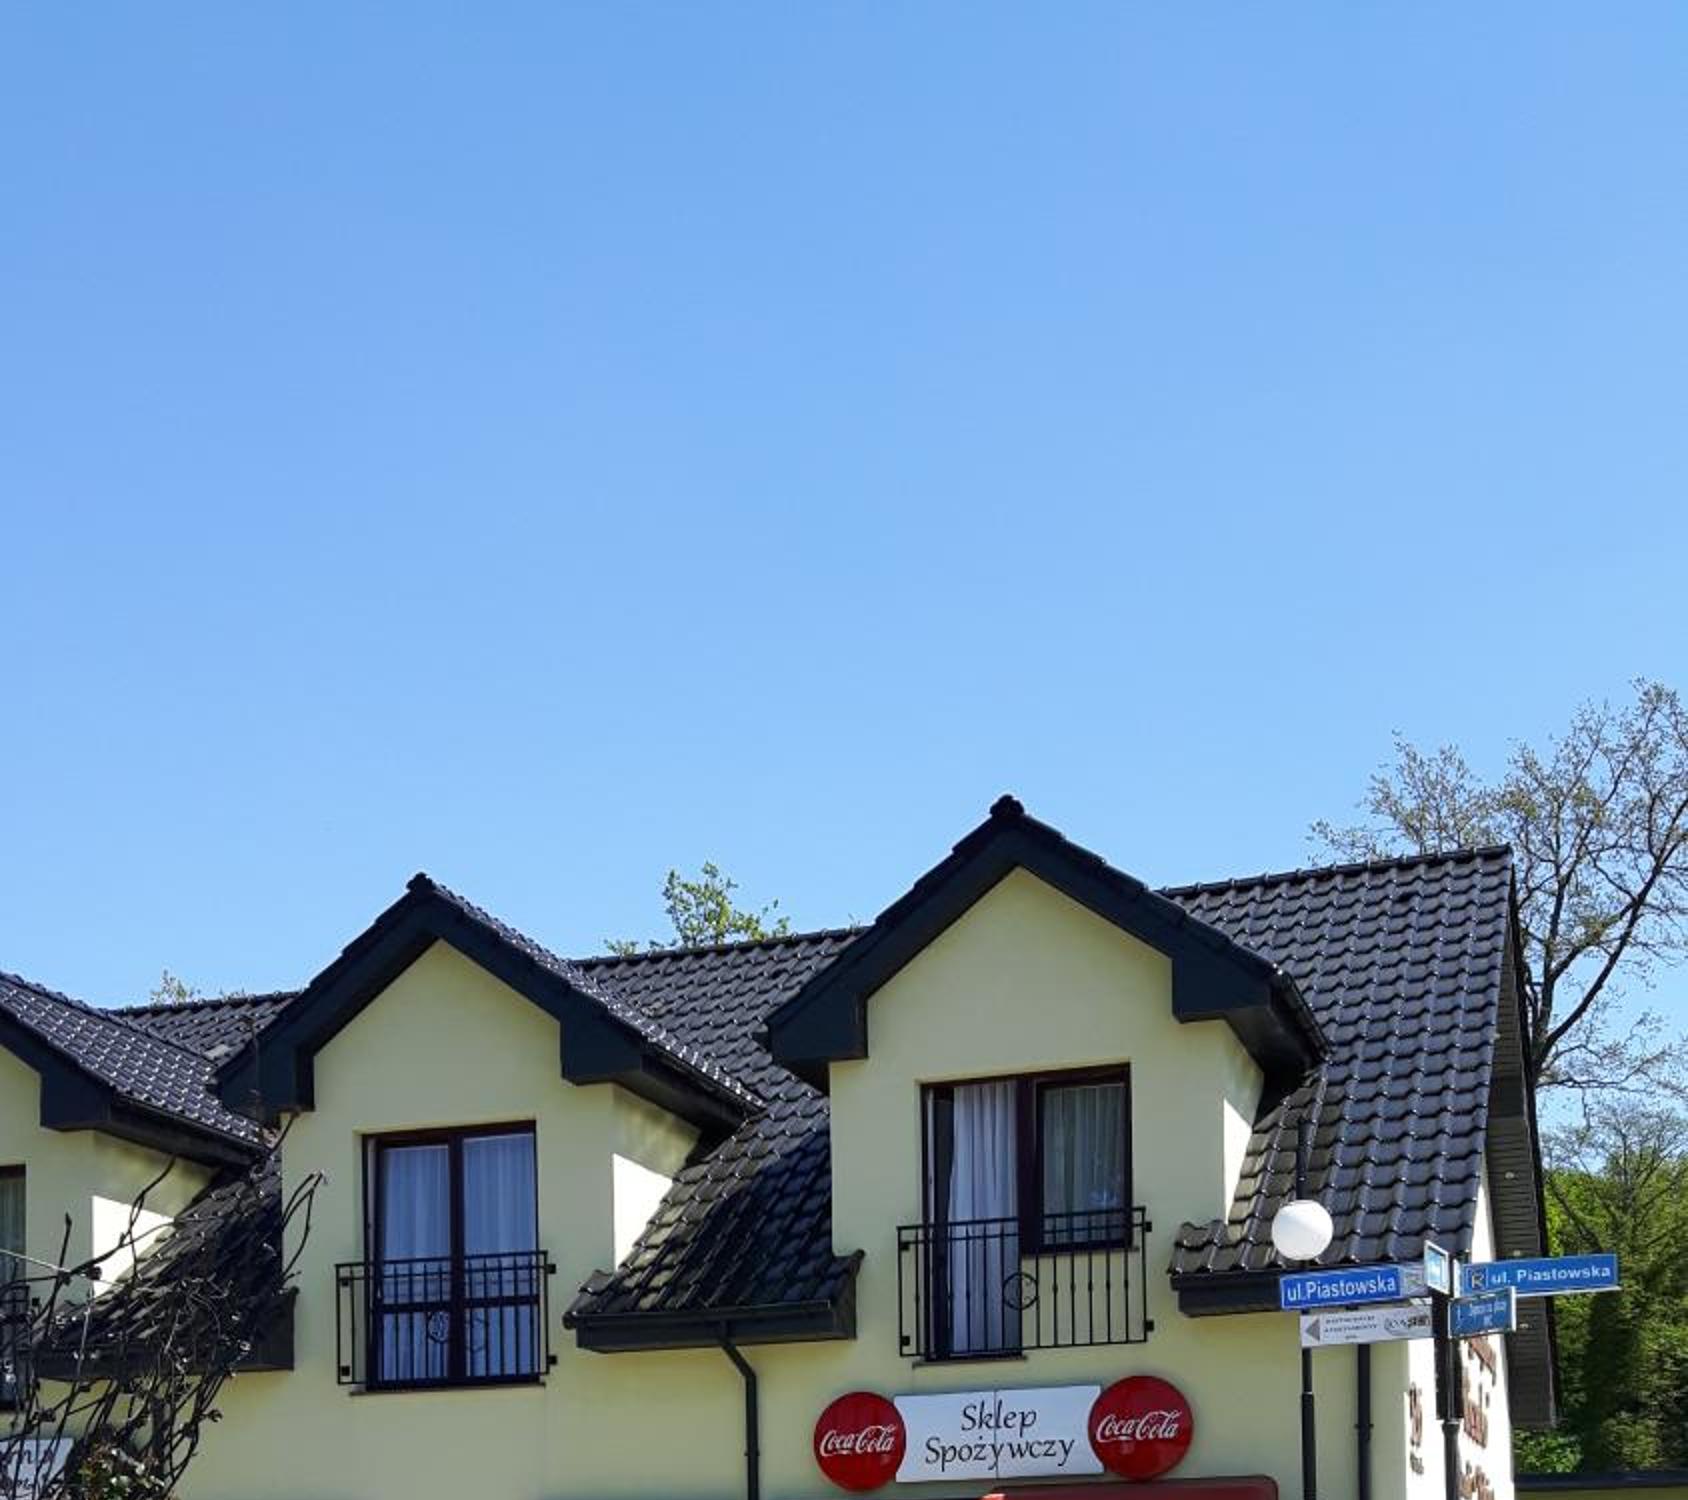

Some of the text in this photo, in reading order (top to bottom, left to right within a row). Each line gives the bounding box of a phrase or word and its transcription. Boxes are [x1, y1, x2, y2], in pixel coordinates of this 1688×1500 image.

[1516, 1264, 1612, 1284] Piastowska
[961, 1399, 1038, 1438] Sklep
[1096, 1409, 1182, 1443] Coca-Cola
[820, 1424, 897, 1457] Coca-Cola
[925, 1435, 1075, 1472] Spożywczy
